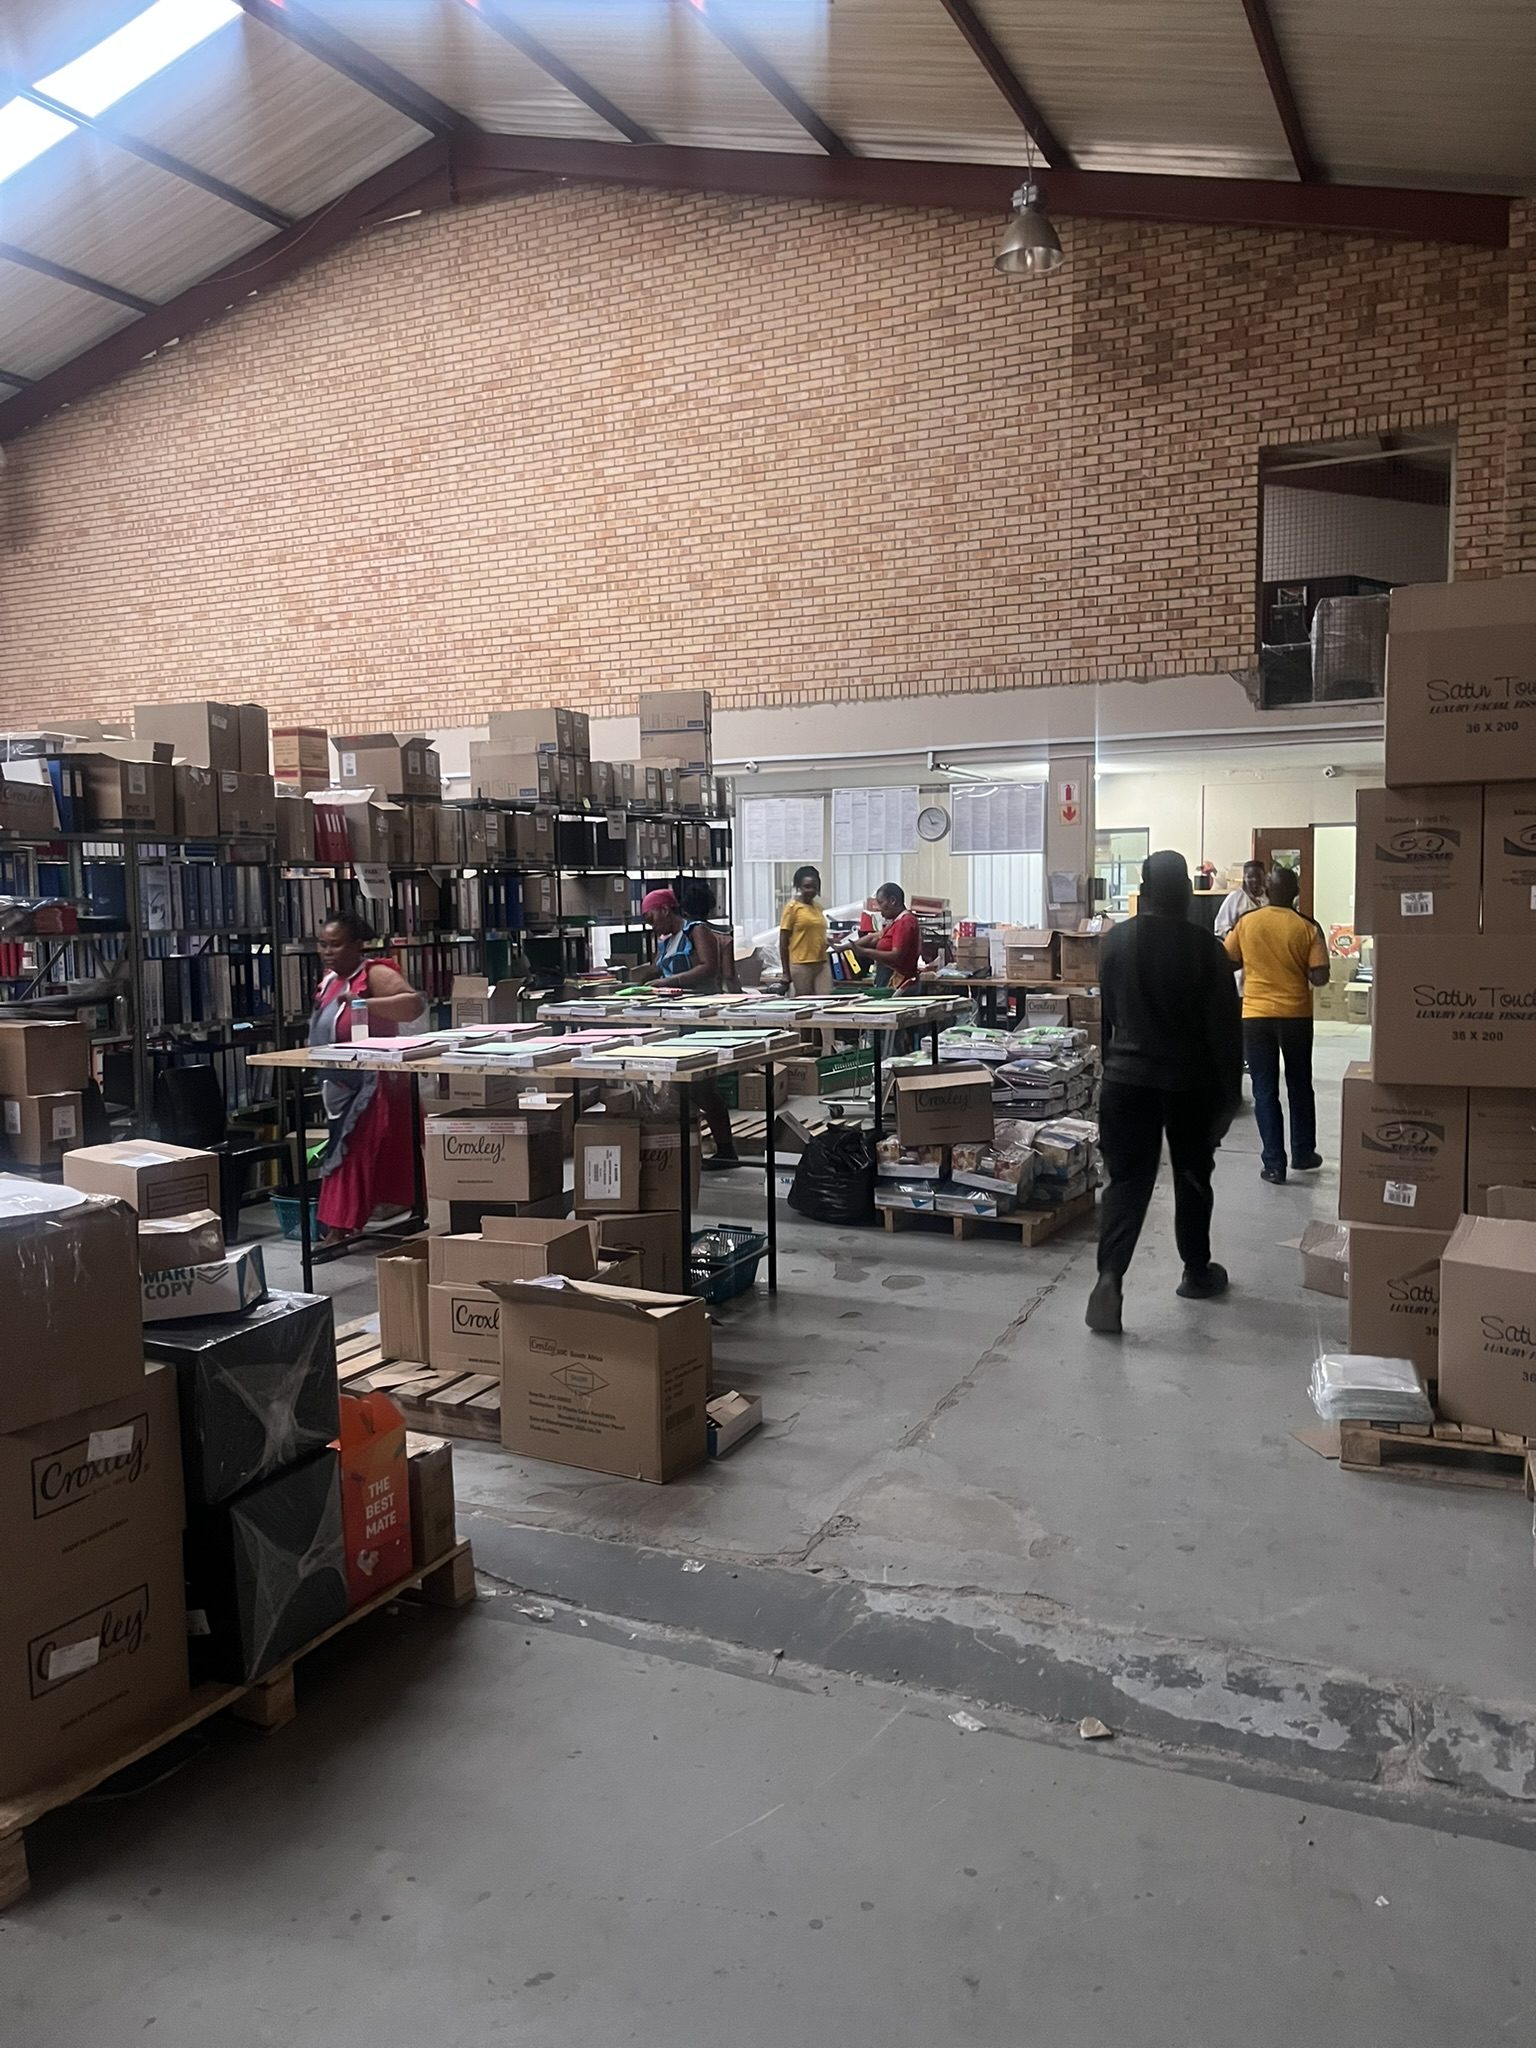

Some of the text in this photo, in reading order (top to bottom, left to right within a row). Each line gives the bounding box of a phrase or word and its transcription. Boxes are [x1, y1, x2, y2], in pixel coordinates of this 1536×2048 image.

[1493, 675, 1536, 697] Tou
[1496, 721, 1519, 732] 200
[1413, 985, 1536, 1008] Satin Touc
[1482, 1031, 1504, 1041] 200
[447, 1135, 502, 1164] Croxley
[144, 1281, 194, 1300] COPY
[456, 1304, 500, 1330] Croxl
[368, 1476, 391, 1499] THE
[366, 1493, 395, 1520] BEST
[366, 1510, 397, 1539] MATE
